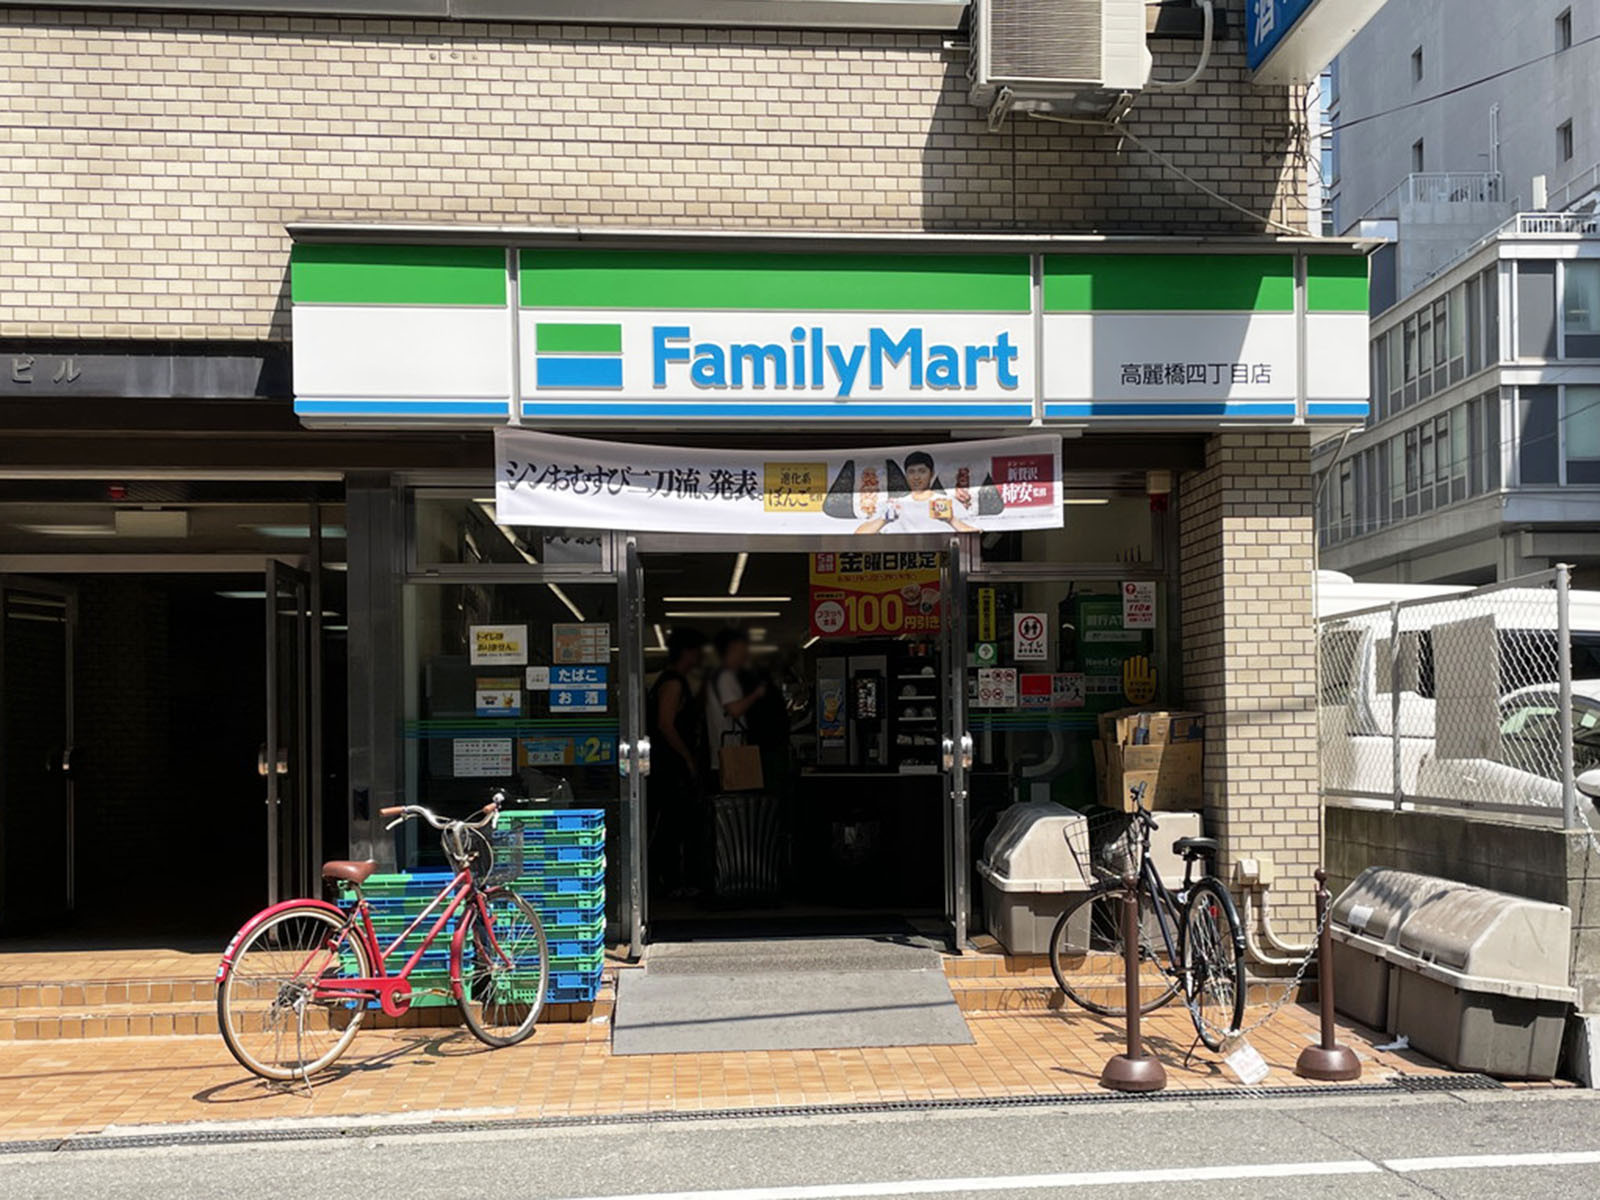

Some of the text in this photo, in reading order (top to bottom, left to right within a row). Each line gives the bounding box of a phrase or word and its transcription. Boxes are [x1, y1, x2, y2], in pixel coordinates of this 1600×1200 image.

[11, 356, 82, 384] ビル
[652, 326, 1018, 397] FamilyMart
[1121, 362, 1272, 386] 高麗橋四丁目店
[506, 460, 764, 501] シンおむすび二刀流、発表。
[840, 552, 937, 571] 金曜日限定
[558, 668, 598, 682] たばこ
